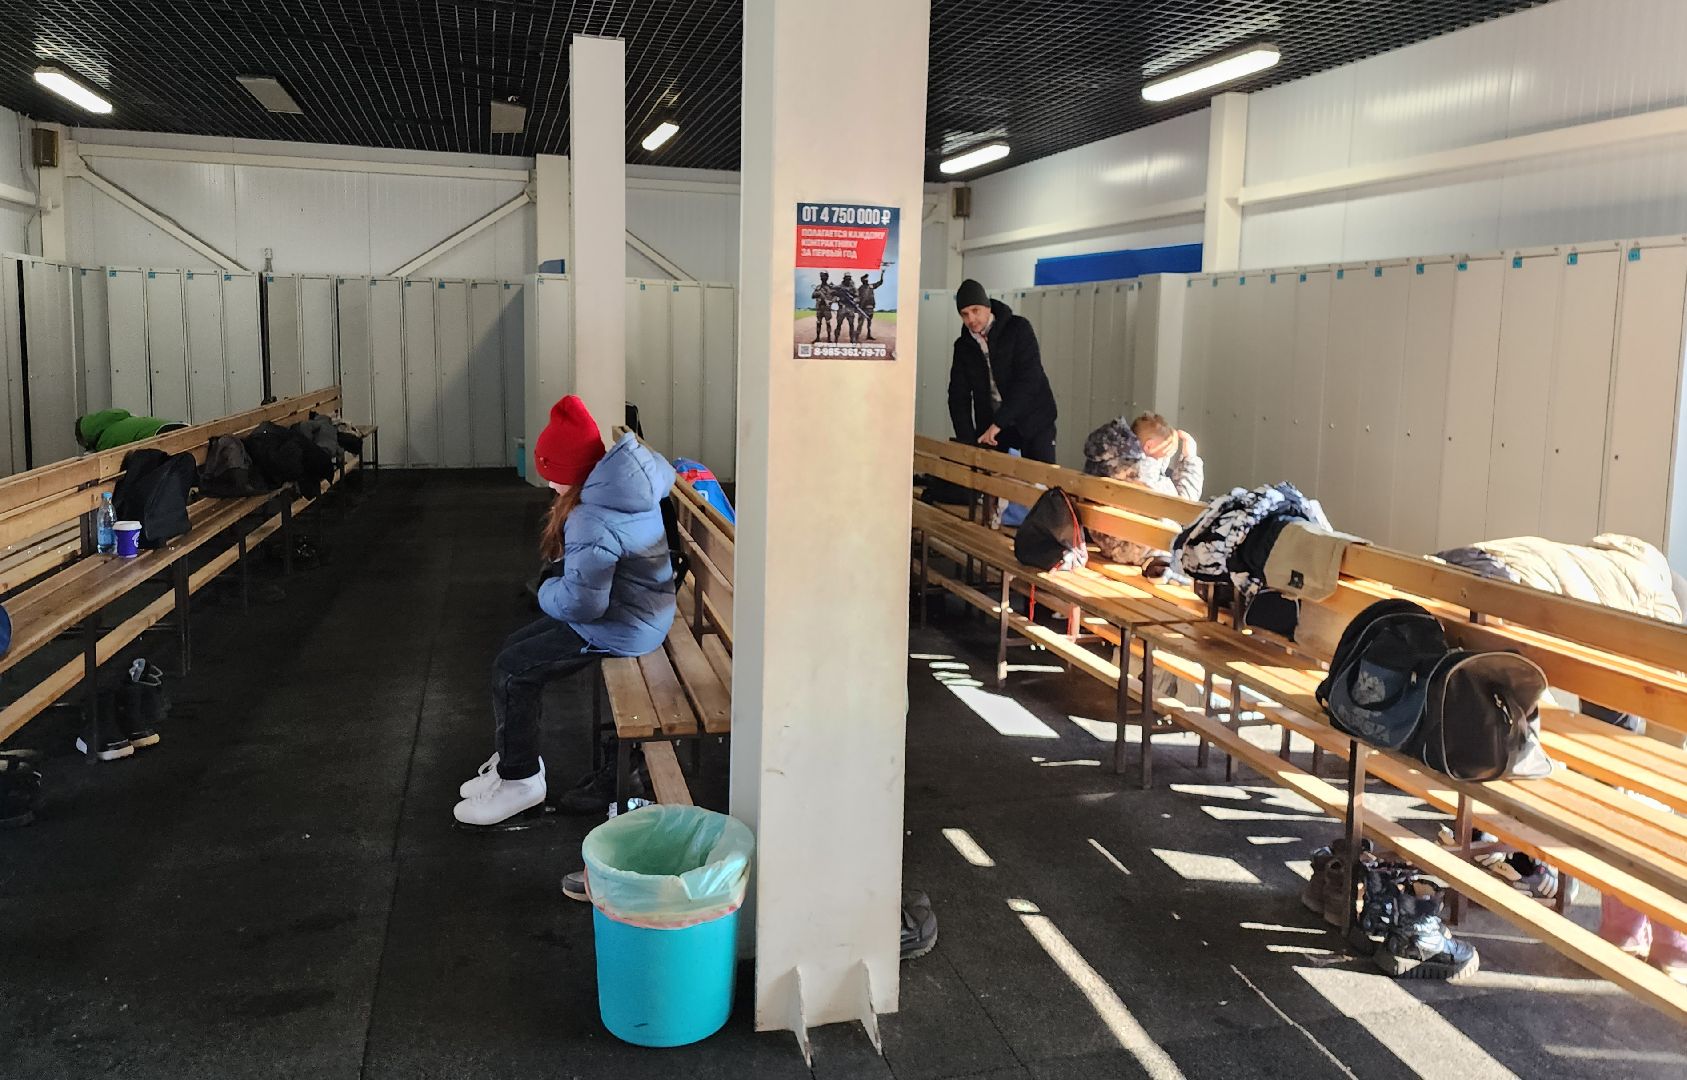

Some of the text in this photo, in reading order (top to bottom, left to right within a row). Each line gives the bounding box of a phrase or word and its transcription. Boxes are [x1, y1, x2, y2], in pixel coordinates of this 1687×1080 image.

[802, 206, 818, 222] ОТ
[820, 207, 829, 223] 4
[831, 207, 855, 224] 750
[801, 229, 885, 240] ПОЛАГАЕТСЯ КАЖДОМУ
[801, 239, 858, 248] КОНТРАКТНИКУ
[801, 248, 857, 259] ЗА ПЕРВЫЙ ГОД
